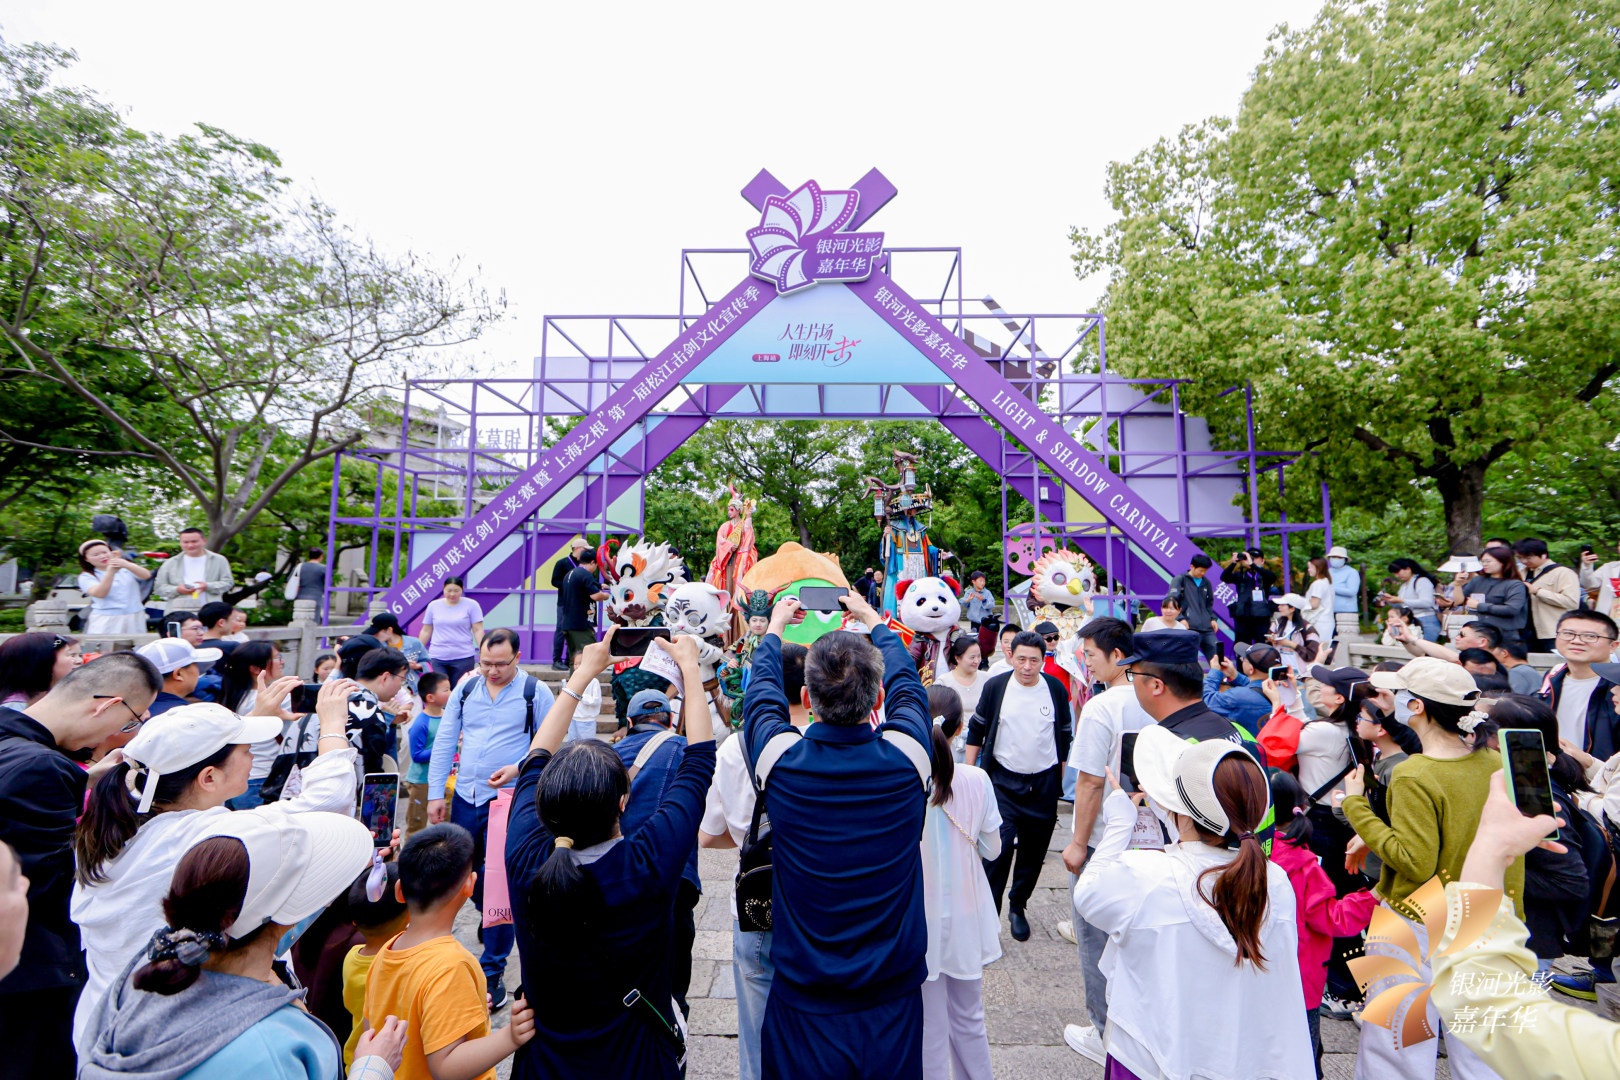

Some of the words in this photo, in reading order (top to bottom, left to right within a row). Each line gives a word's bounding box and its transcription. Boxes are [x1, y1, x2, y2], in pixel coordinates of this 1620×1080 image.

[815, 237, 881, 254] 银河光影
[816, 257, 867, 274] 嘉年华
[778, 323, 834, 341] 人生片场
[874, 286, 968, 370] 银河光影嘉年华
[992, 390, 1036, 431] LIGHT
[1035, 429, 1048, 444] &
[1050, 441, 1109, 495] SHADOW
[1110, 494, 1178, 558] CARNIVAL
